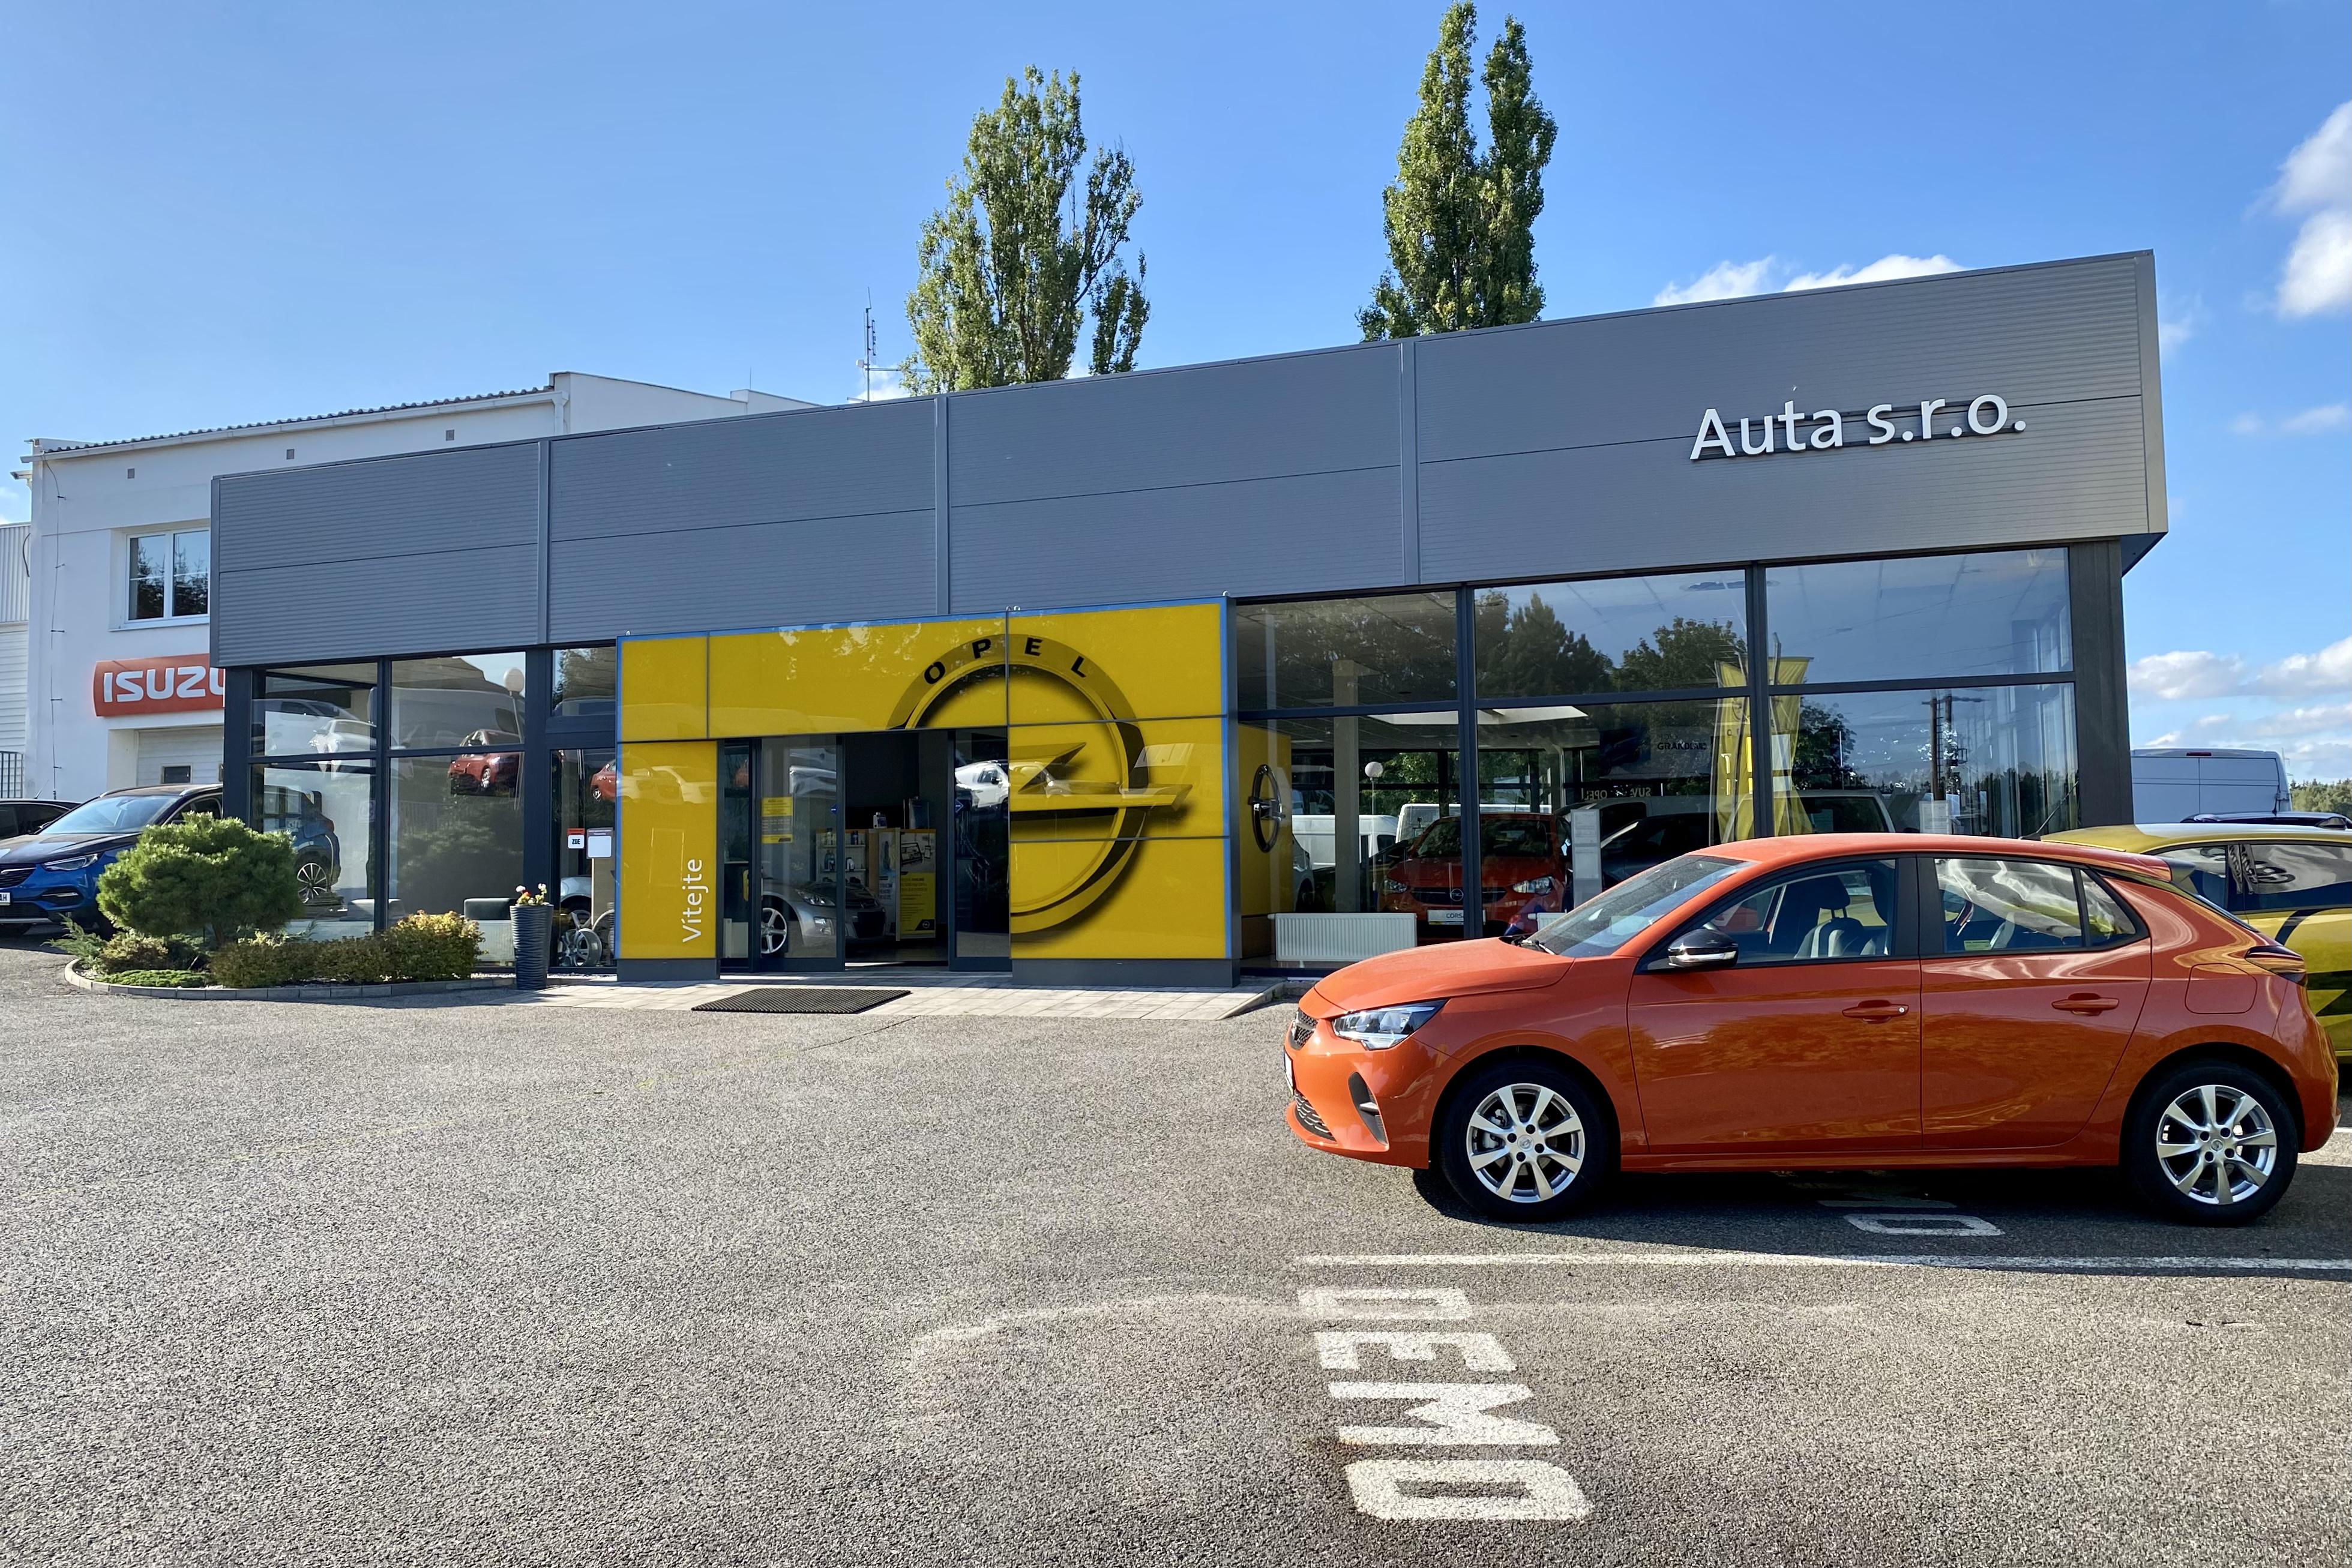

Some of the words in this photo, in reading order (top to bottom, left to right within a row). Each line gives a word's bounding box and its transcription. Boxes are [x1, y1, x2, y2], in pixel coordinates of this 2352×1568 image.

[1689, 400, 1842, 460] Auta
[1867, 394, 2027, 445] s.r.o.
[923, 637, 1087, 684] OPEL
[681, 859, 709, 943] Vítejte
[1297, 1288, 1593, 1521] DEMO
